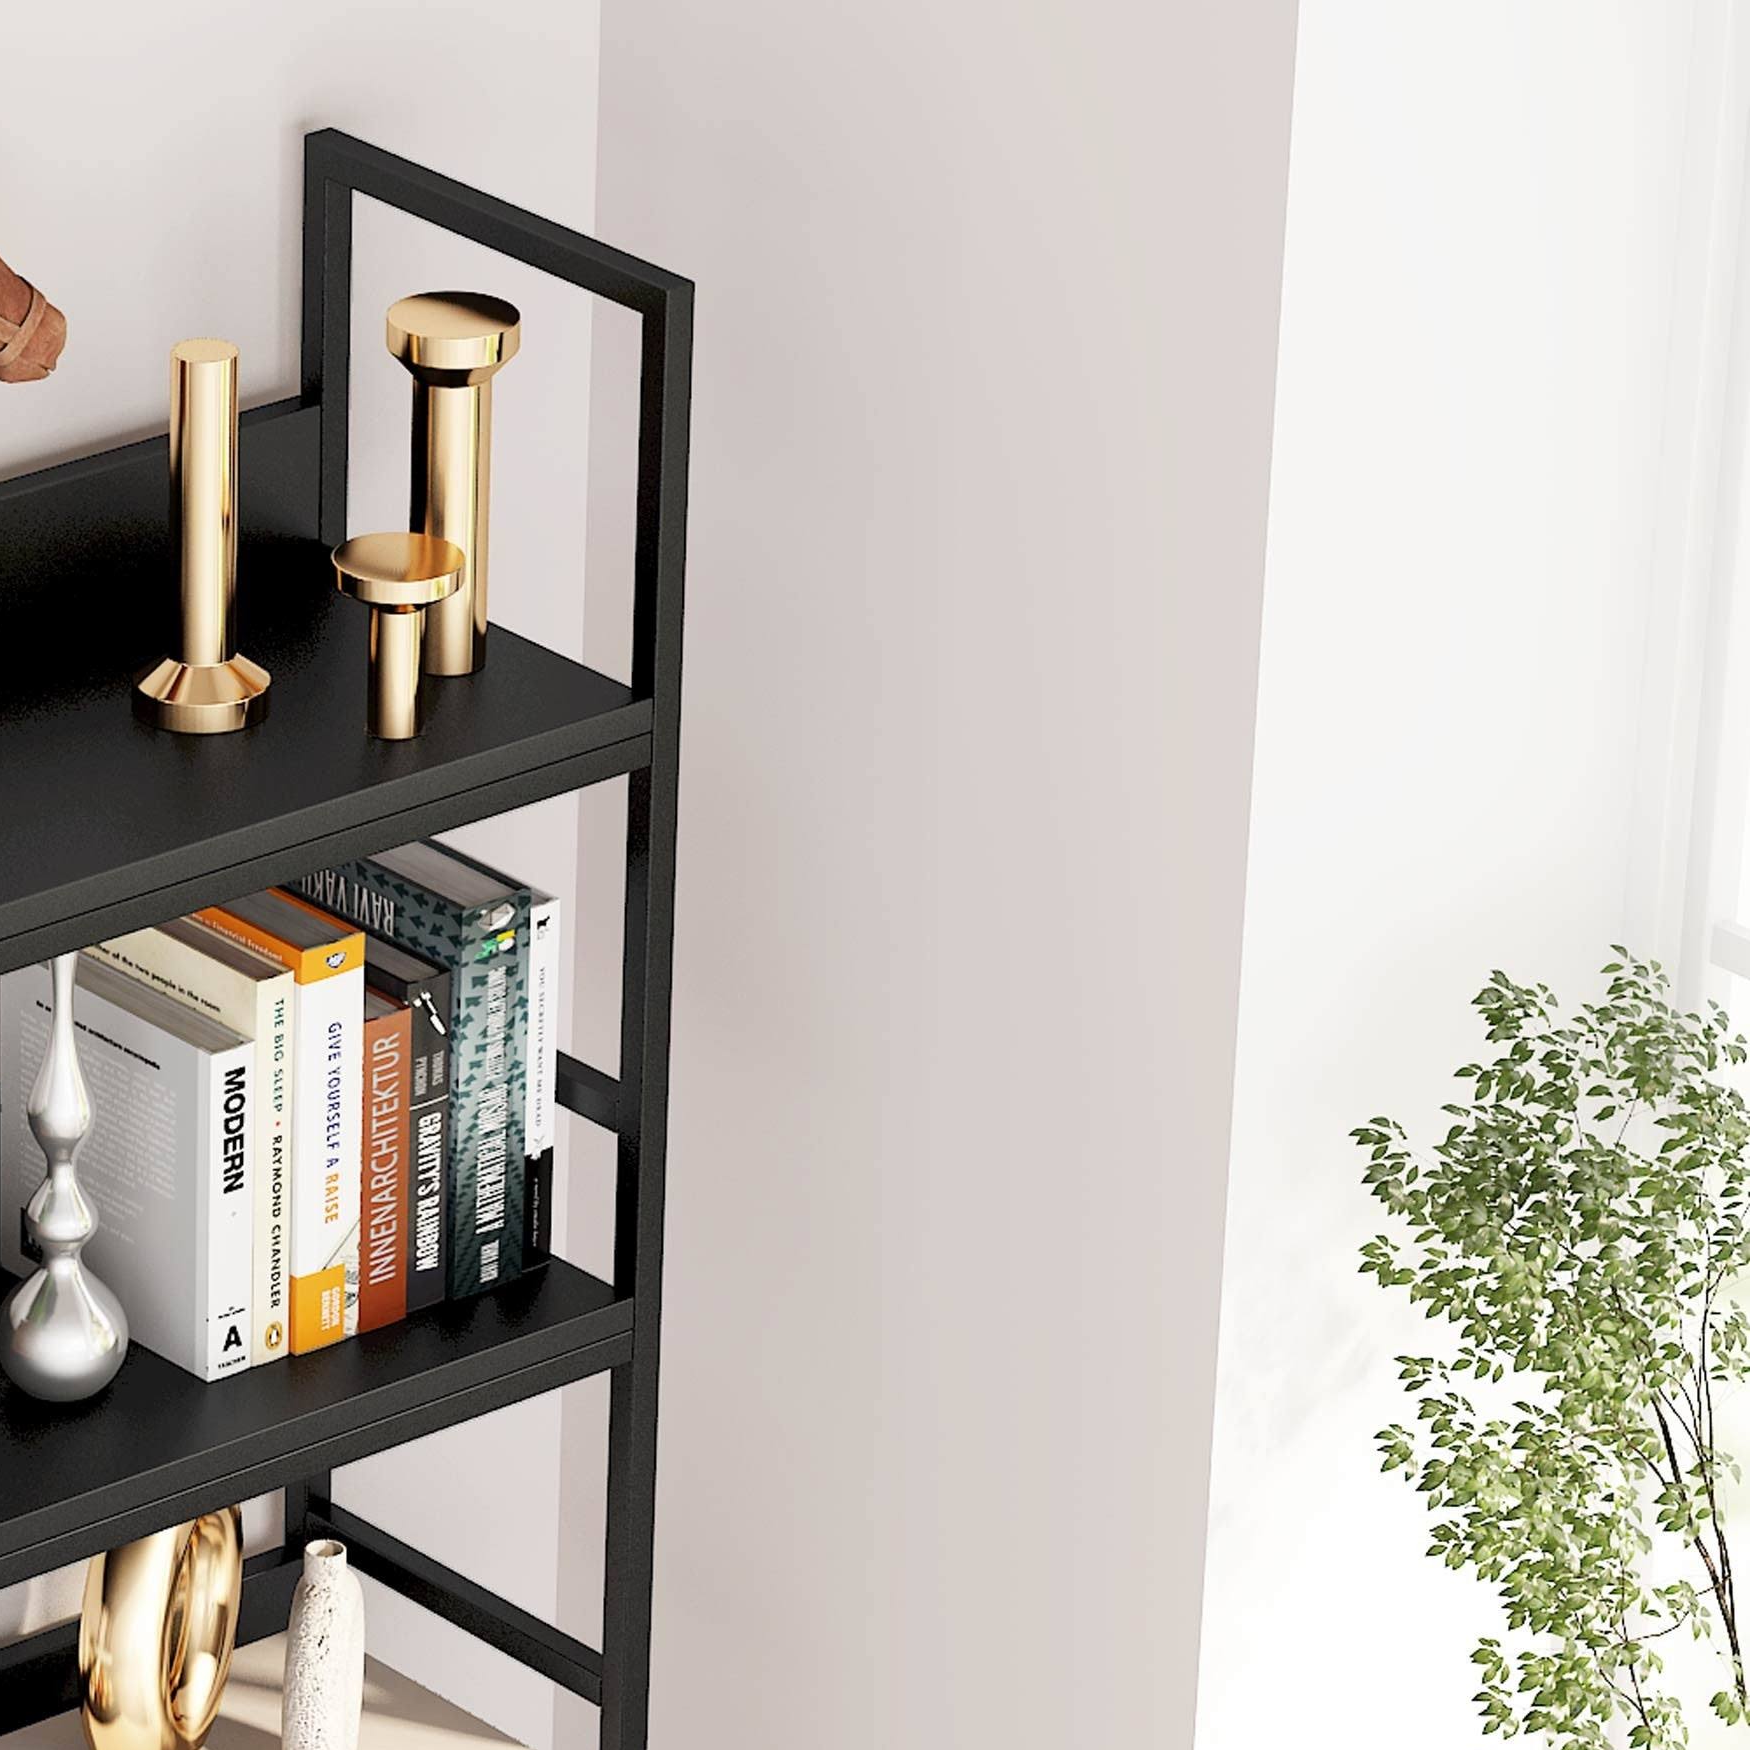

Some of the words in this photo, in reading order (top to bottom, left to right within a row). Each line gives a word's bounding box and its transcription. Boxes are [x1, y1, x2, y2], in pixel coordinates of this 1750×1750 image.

[354, 883, 395, 937] RAVI
[151, 972, 176, 991] people
[274, 999, 285, 1028] THE
[274, 1032, 285, 1062] BIG
[327, 1021, 342, 1061] GIVE
[273, 1068, 284, 1112] SLEEP
[326, 1066, 341, 1150] YOURSELF
[223, 1065, 246, 1194] MODERN
[417, 1111, 442, 1197] GRAVITY'S
[272, 1134, 283, 1218] RAYMOND
[326, 1157, 340, 1169] A
[368, 1031, 401, 1286] INNENARCHITEKTUR
[324, 1172, 339, 1224] RAISE
[415, 1194, 440, 1272] RAINBOW
[270, 1224, 282, 1309] CHANDLER
[222, 1325, 243, 1352] A
